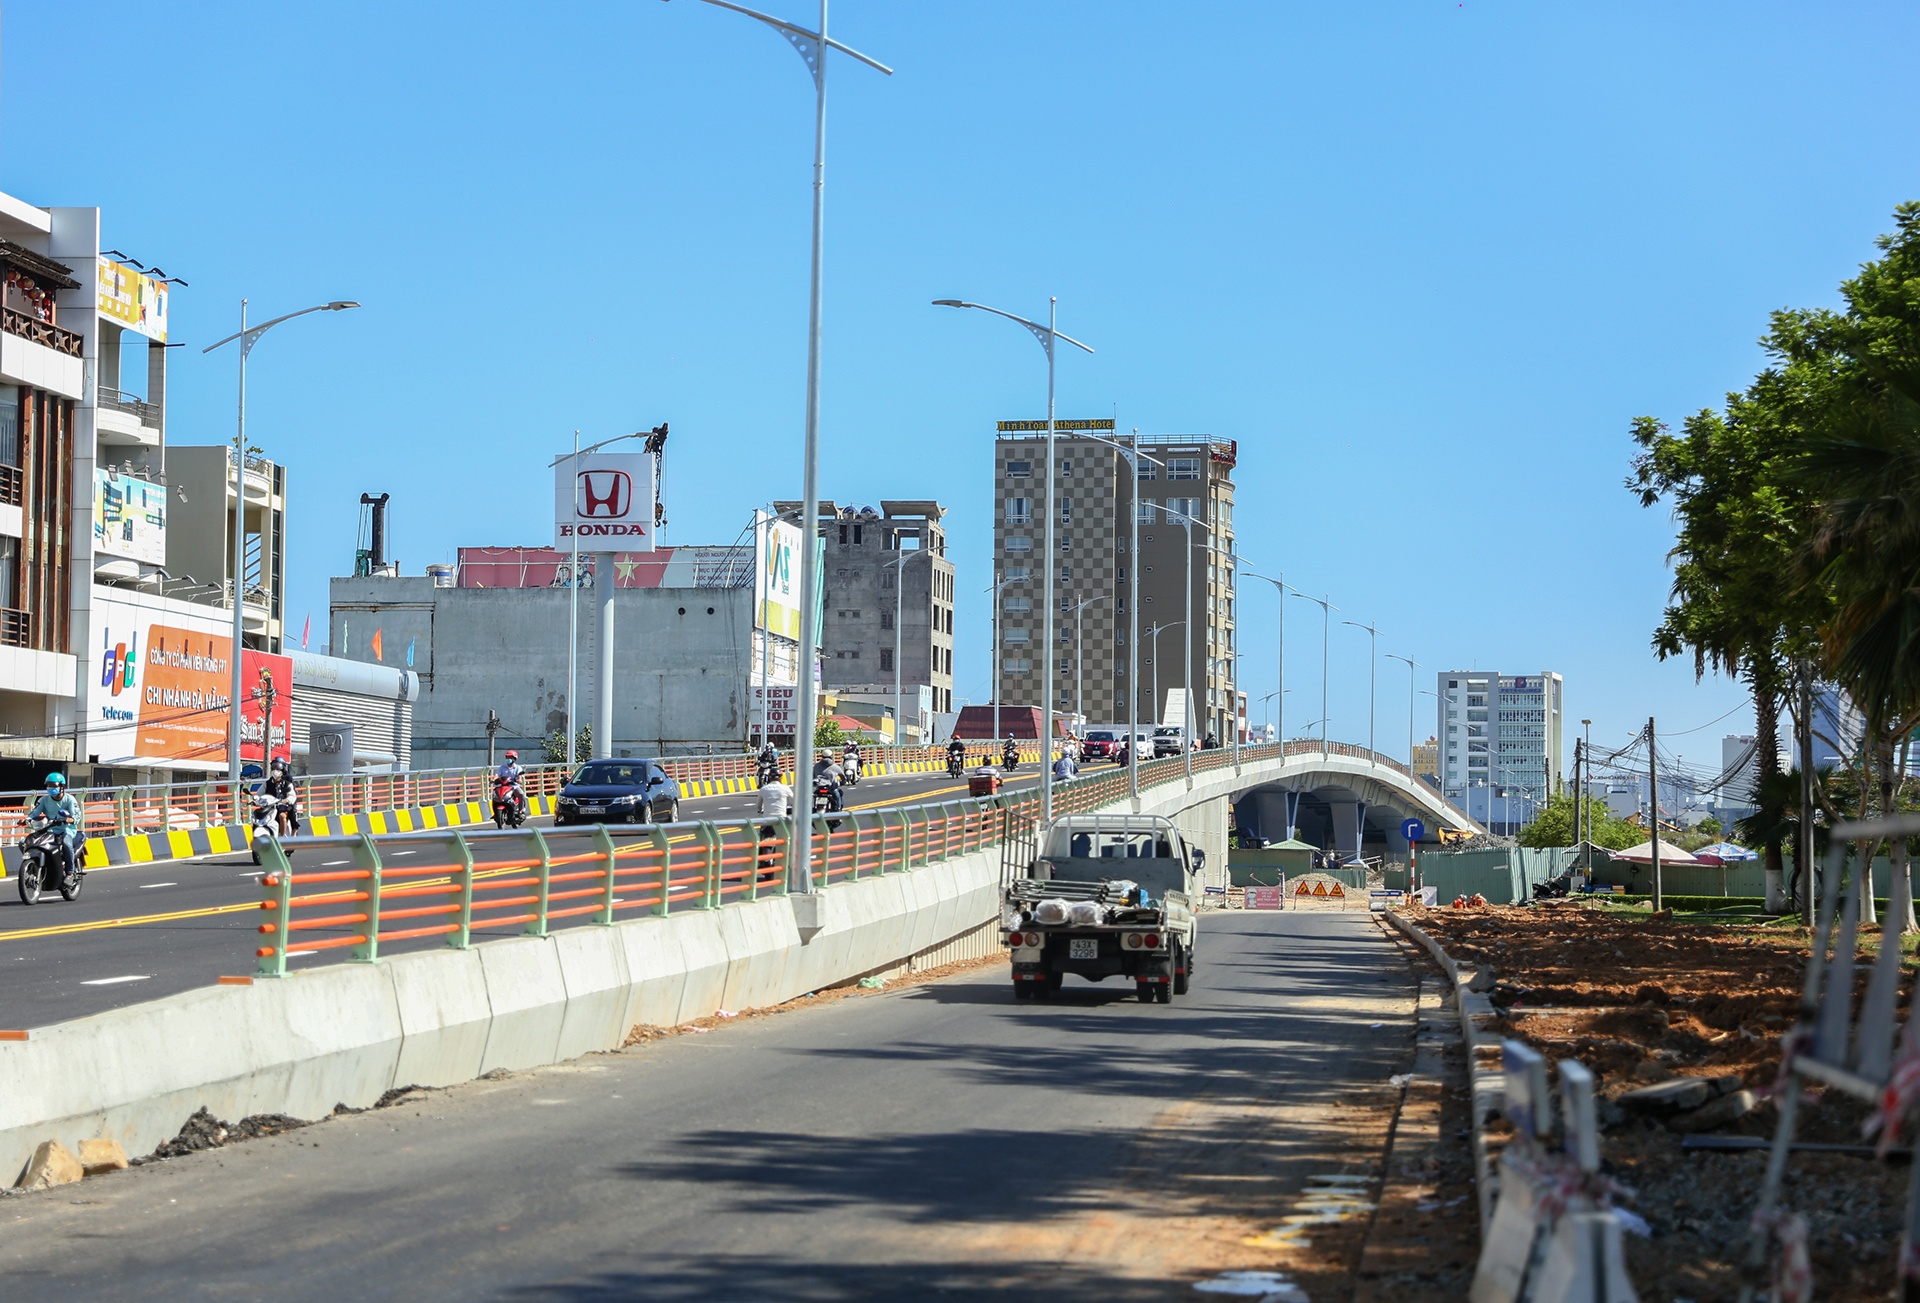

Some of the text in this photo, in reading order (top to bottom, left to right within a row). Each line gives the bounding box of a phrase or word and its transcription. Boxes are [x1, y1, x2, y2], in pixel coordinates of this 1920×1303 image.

[997, 420, 1025, 430] Minh
[1054, 420, 1086, 430] Athena
[1089, 420, 1114, 428] Hotel
[560, 524, 646, 536] HONDA
[218, 659, 227, 674] FPT
[146, 686, 161, 704] CHI
[162, 685, 191, 708] NHÁNH
[192, 688, 203, 710] ĐÀ
[102, 706, 133, 721] Telecom
[240, 715, 258, 740] San
[1076, 940, 1092, 949] 43X
